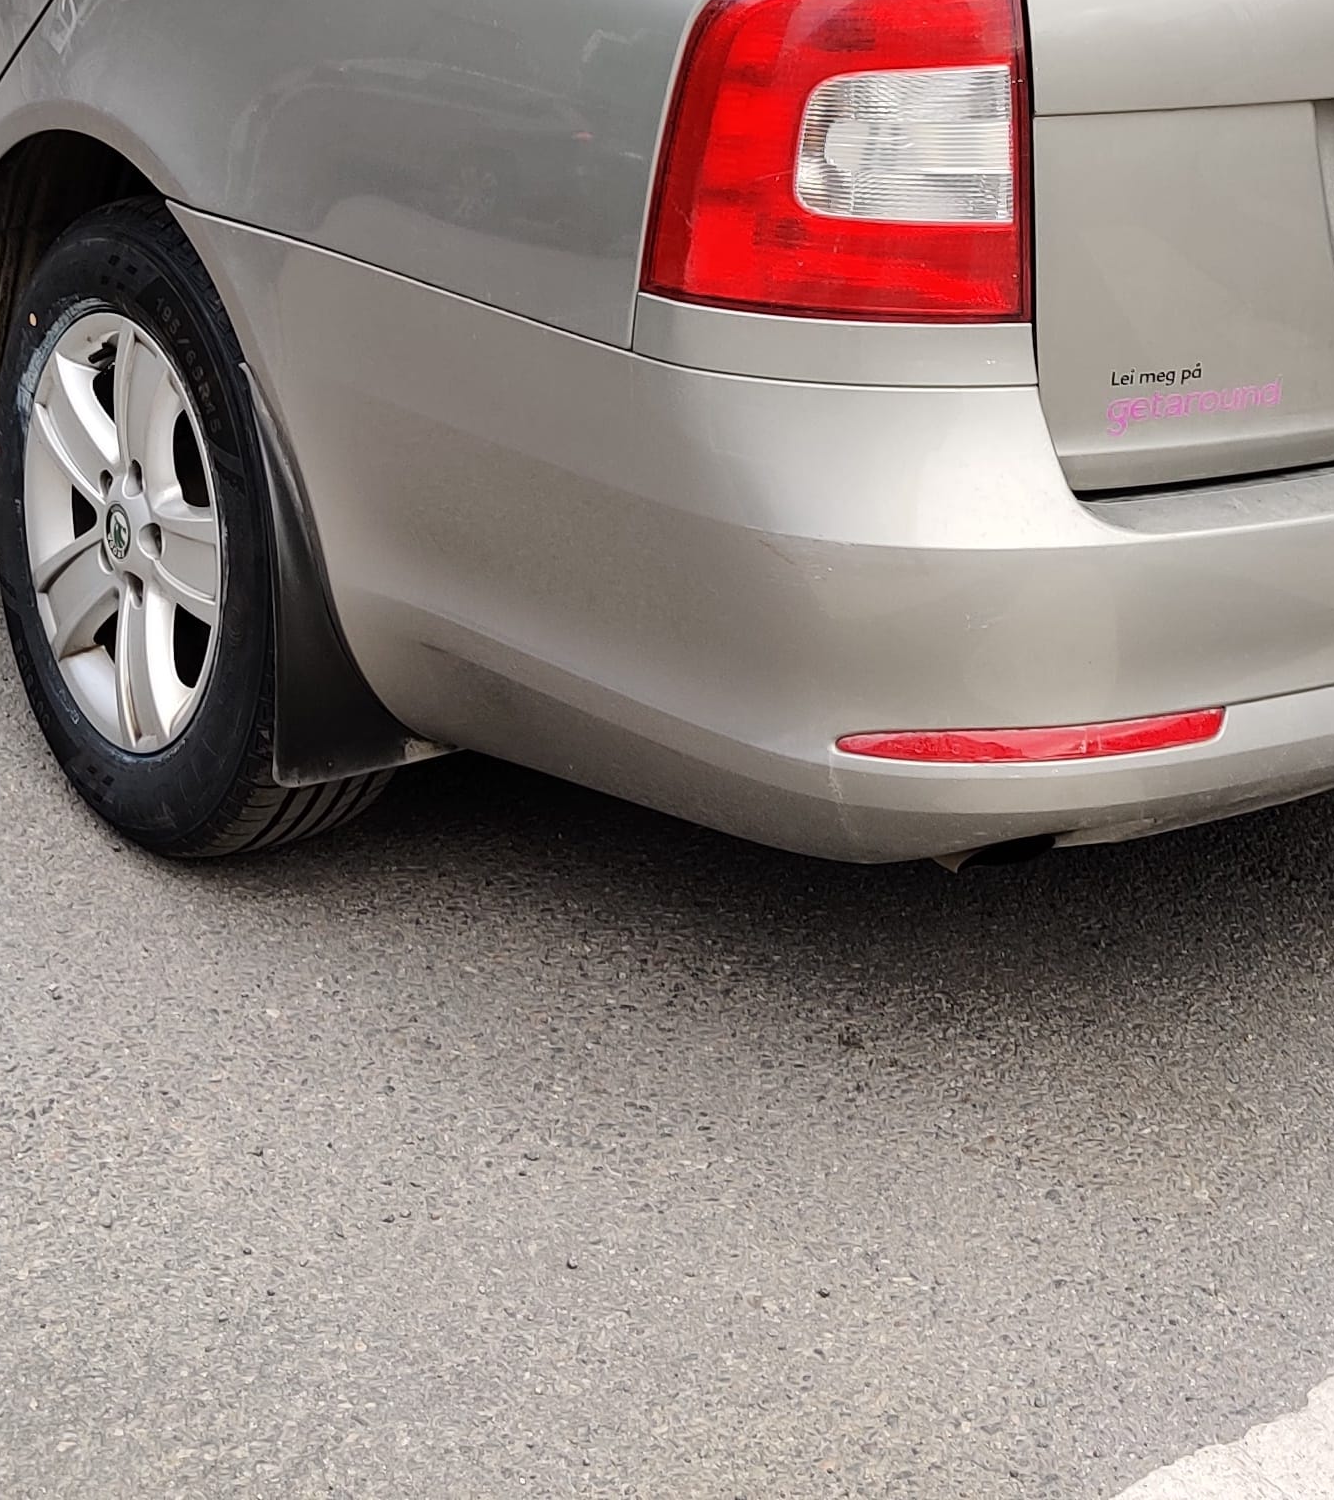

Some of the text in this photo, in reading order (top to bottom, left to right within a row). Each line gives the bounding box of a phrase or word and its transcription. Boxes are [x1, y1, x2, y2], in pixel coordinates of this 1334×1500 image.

[1111, 362, 1202, 386] Lei meg på
[1107, 377, 1283, 437] getaround
